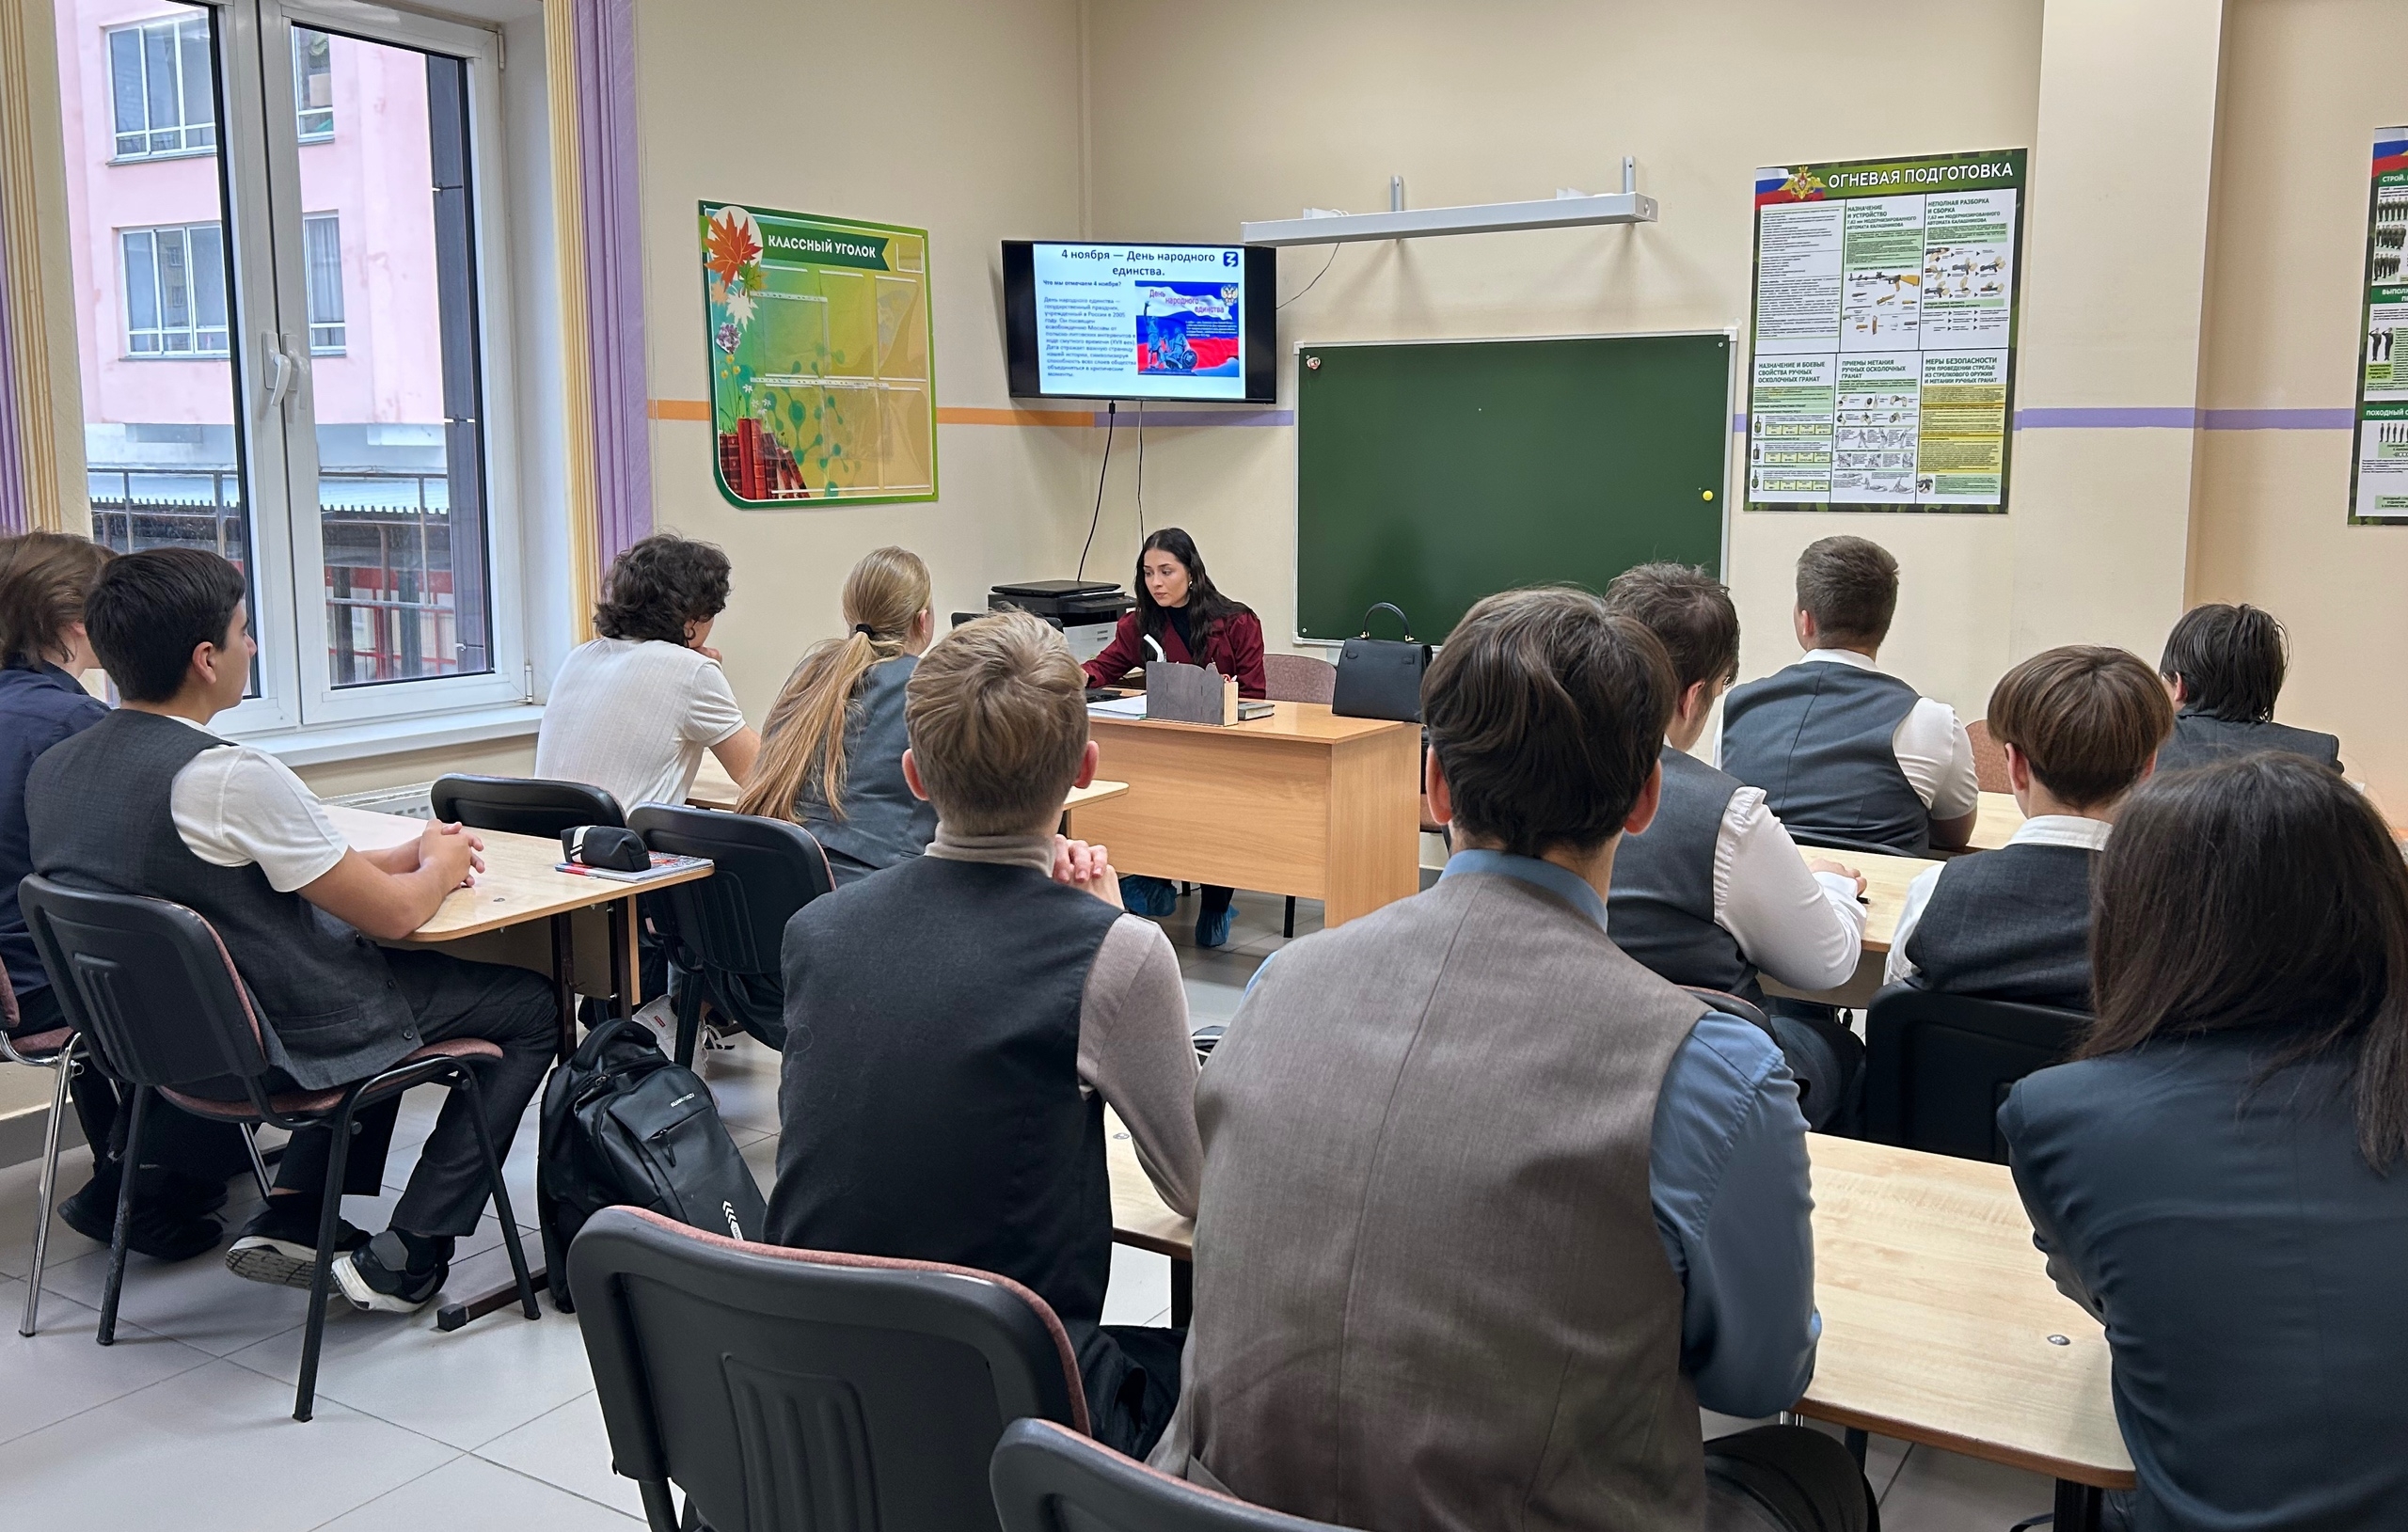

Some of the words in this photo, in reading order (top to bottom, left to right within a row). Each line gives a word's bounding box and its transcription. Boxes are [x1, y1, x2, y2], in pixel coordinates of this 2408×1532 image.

[1828, 169, 1901, 189] ОГНЕВАЯ
[1904, 162, 2013, 184] ПОДГОТОВКА
[768, 234, 832, 253] КЛАССНЫЙ
[834, 242, 876, 258] УГОЛОК
[1061, 249, 1068, 259] 4
[1070, 249, 1110, 261] ноября
[1127, 250, 1155, 261] День
[1157, 252, 1215, 262] народного
[1112, 267, 1165, 276] единства.
[1149, 289, 1165, 298] День
[1195, 306, 1225, 314] единства
[1946, 356, 1998, 365] БЕЗОПАСНОСТИ
[2366, 408, 2404, 417] ПОХОДНЫЙ
